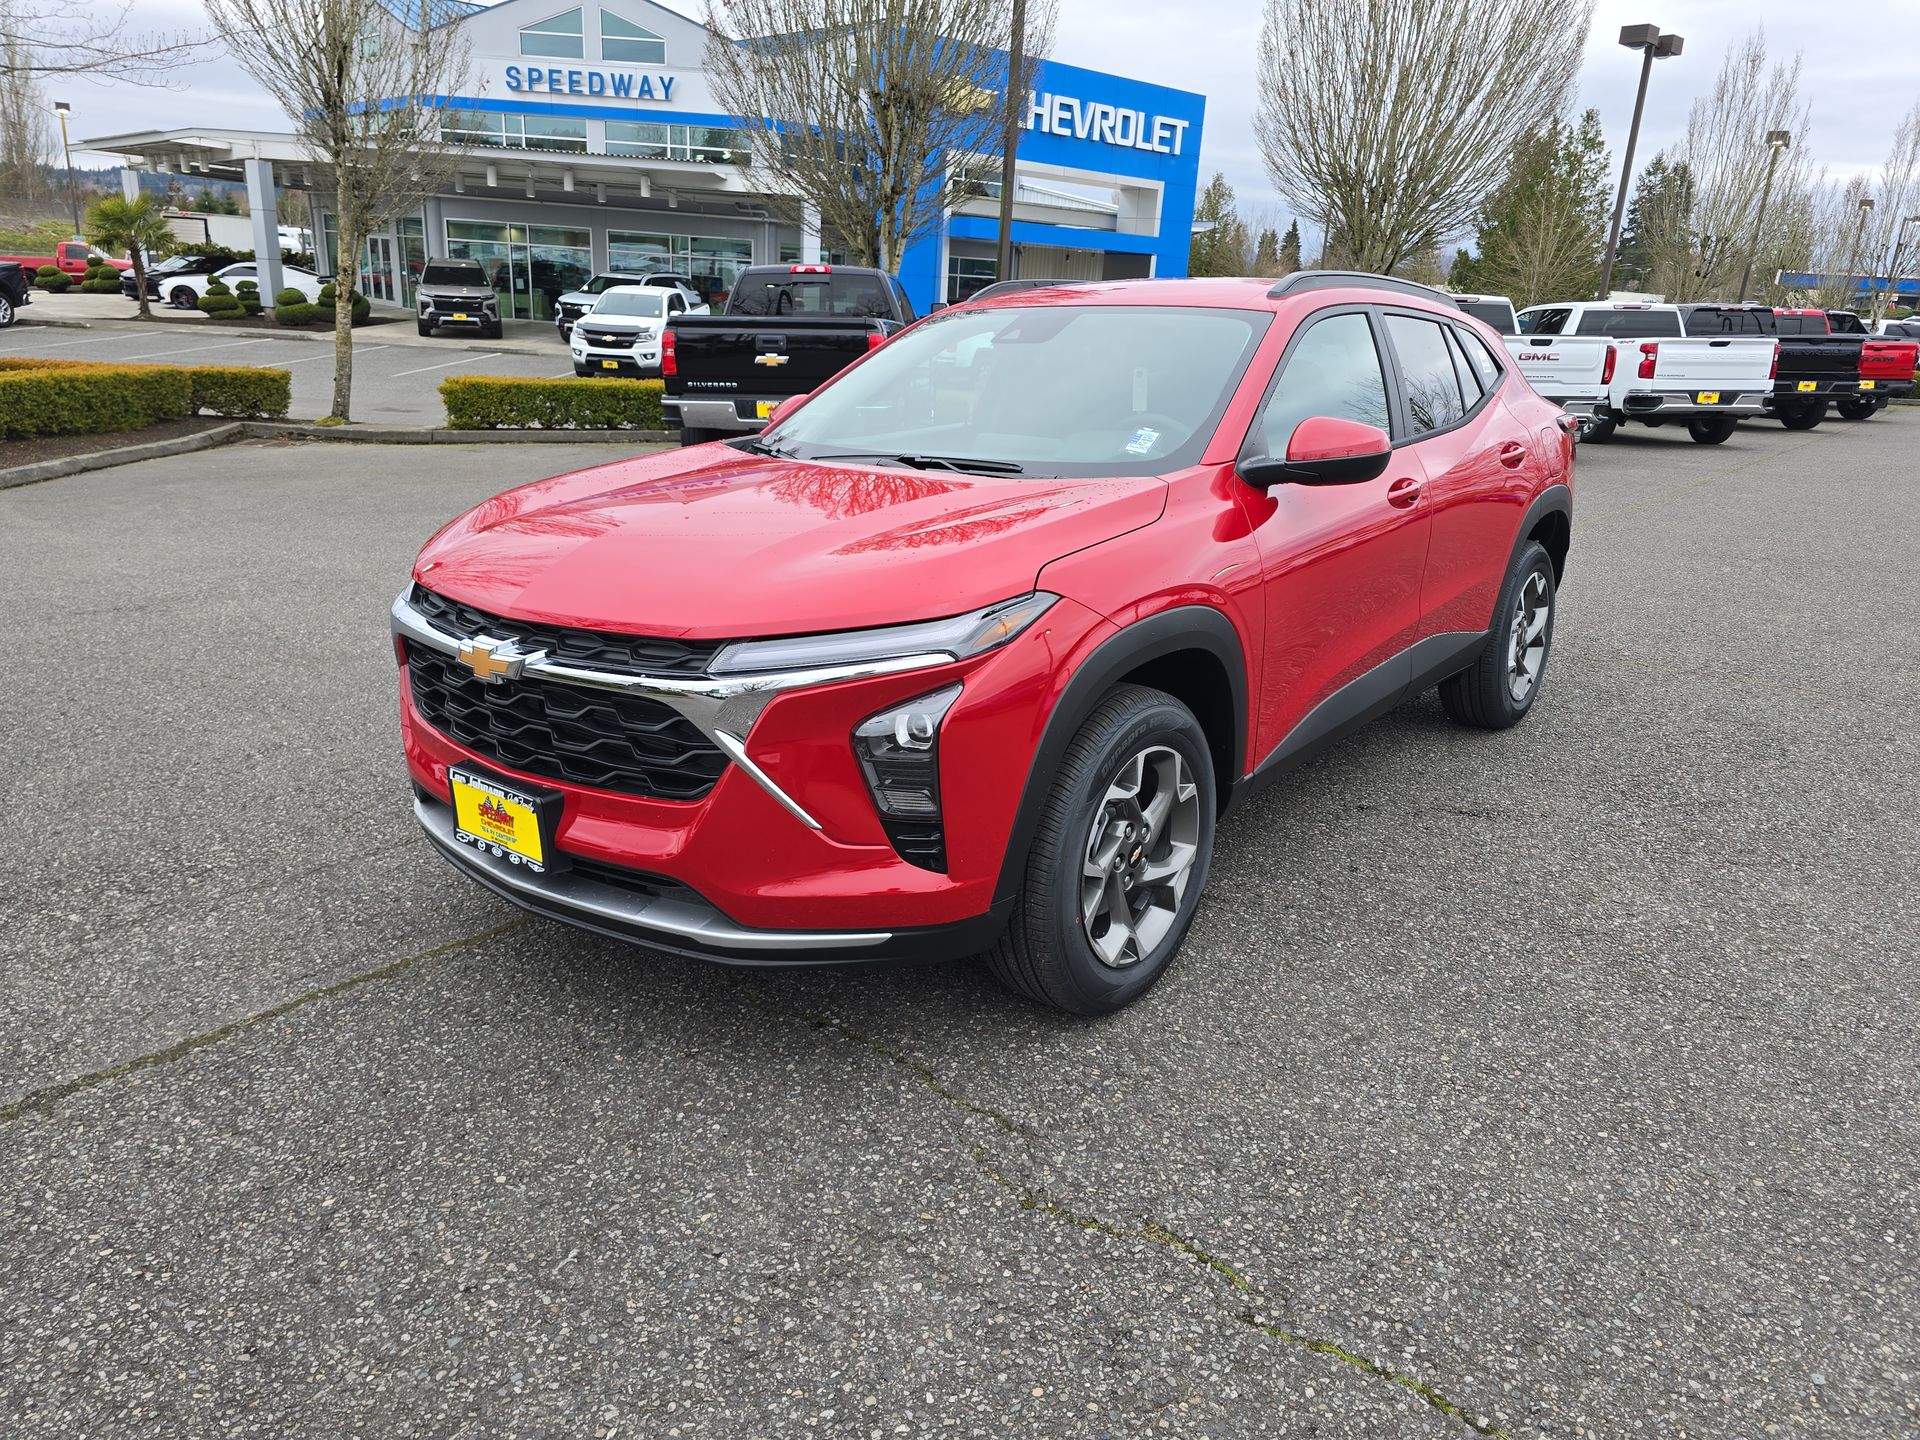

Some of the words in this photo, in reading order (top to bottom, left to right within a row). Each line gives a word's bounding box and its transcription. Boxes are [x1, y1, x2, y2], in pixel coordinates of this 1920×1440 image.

[505, 65, 676, 100] SPEEDWAY
[1018, 83, 1190, 156] HEVROLET
[1518, 352, 1560, 362] GMC
[687, 381, 738, 389] SILVERADO
